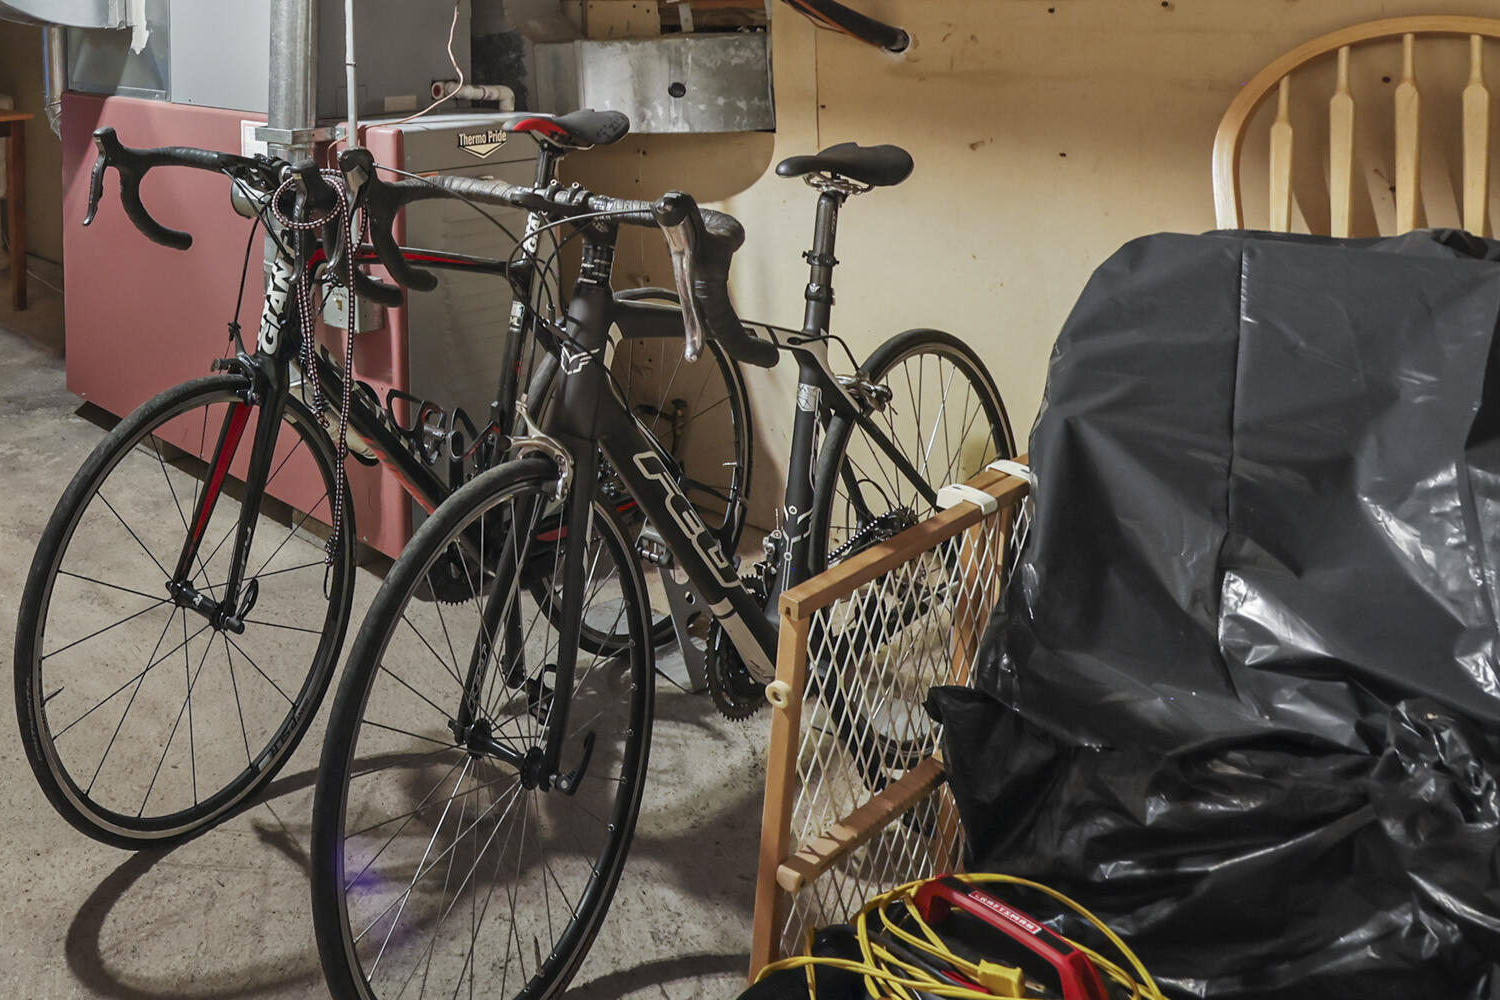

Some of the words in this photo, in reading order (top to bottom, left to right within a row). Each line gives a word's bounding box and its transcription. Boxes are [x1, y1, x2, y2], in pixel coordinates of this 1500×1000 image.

[459, 133, 487, 146] Thermo
[488, 130, 507, 143] Pride
[975, 894, 1034, 929] CRAFTSMAN
